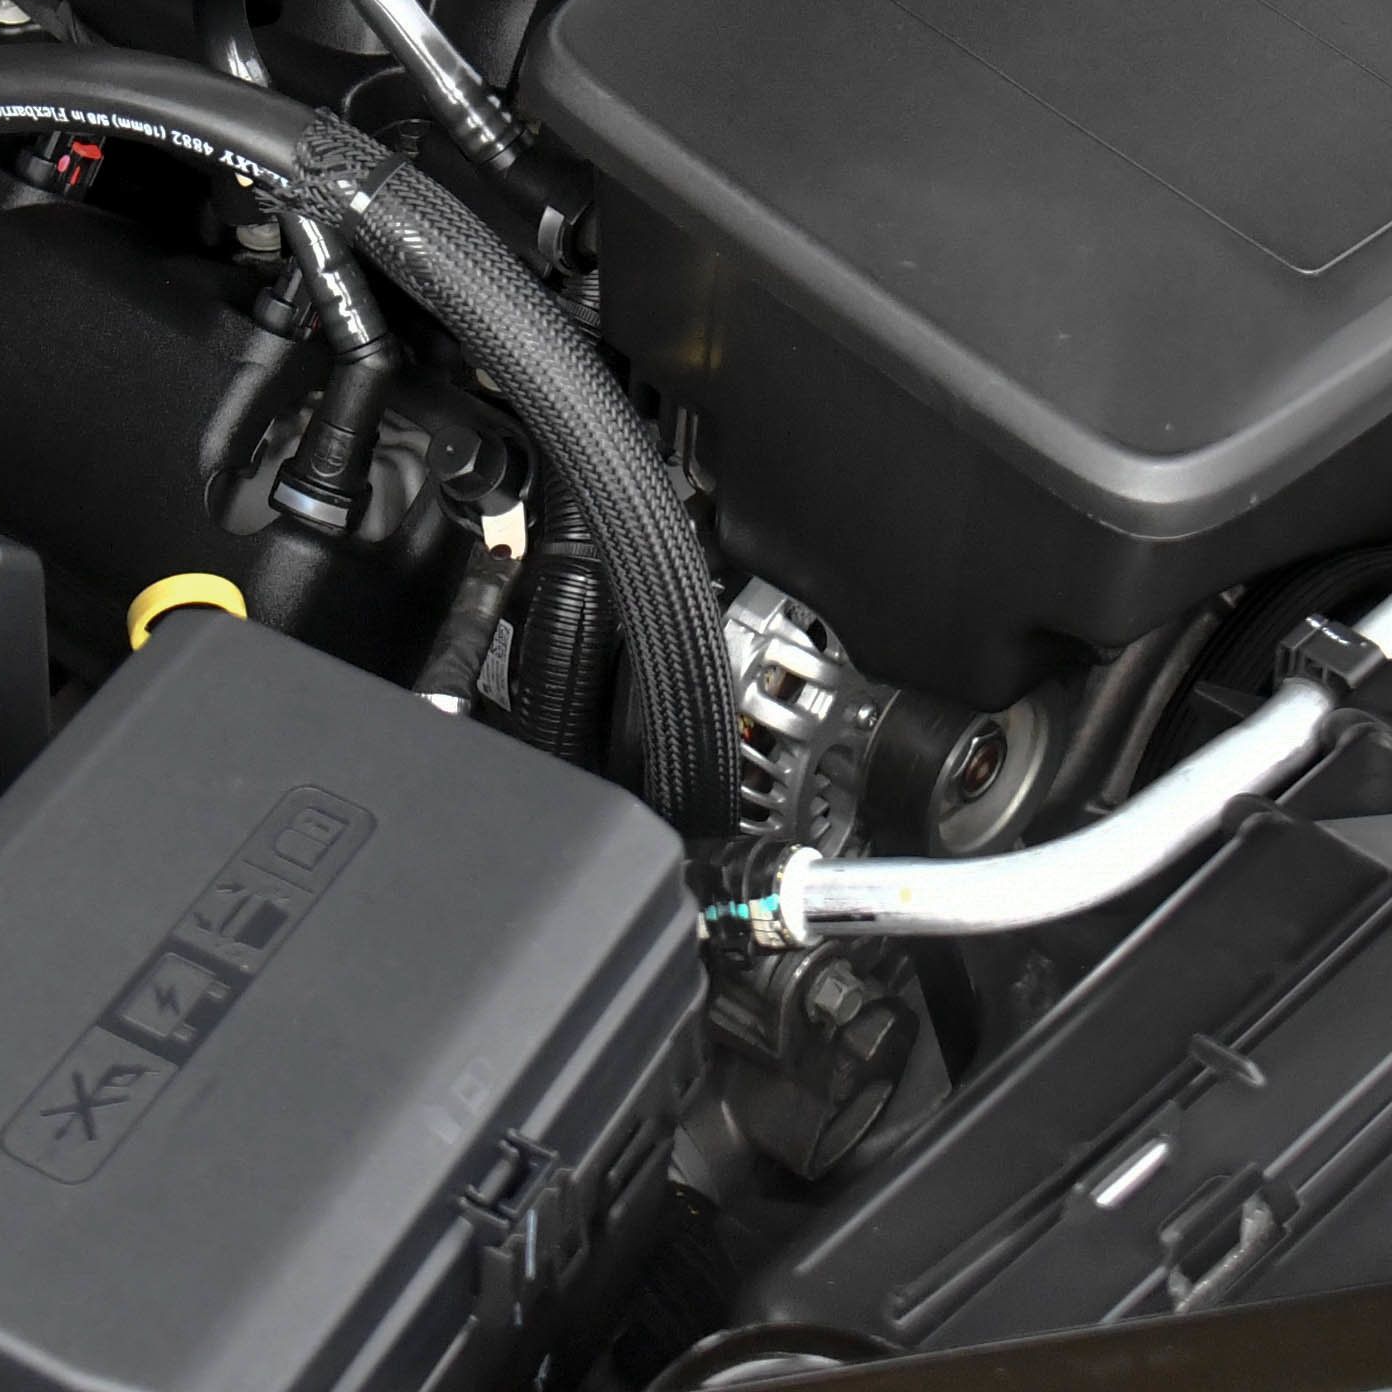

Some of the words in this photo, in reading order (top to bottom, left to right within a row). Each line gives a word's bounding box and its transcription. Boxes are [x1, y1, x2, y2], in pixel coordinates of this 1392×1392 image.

[71, 109, 86, 123] in
[86, 112, 110, 127] 5/8
[171, 130, 214, 156] 4882
